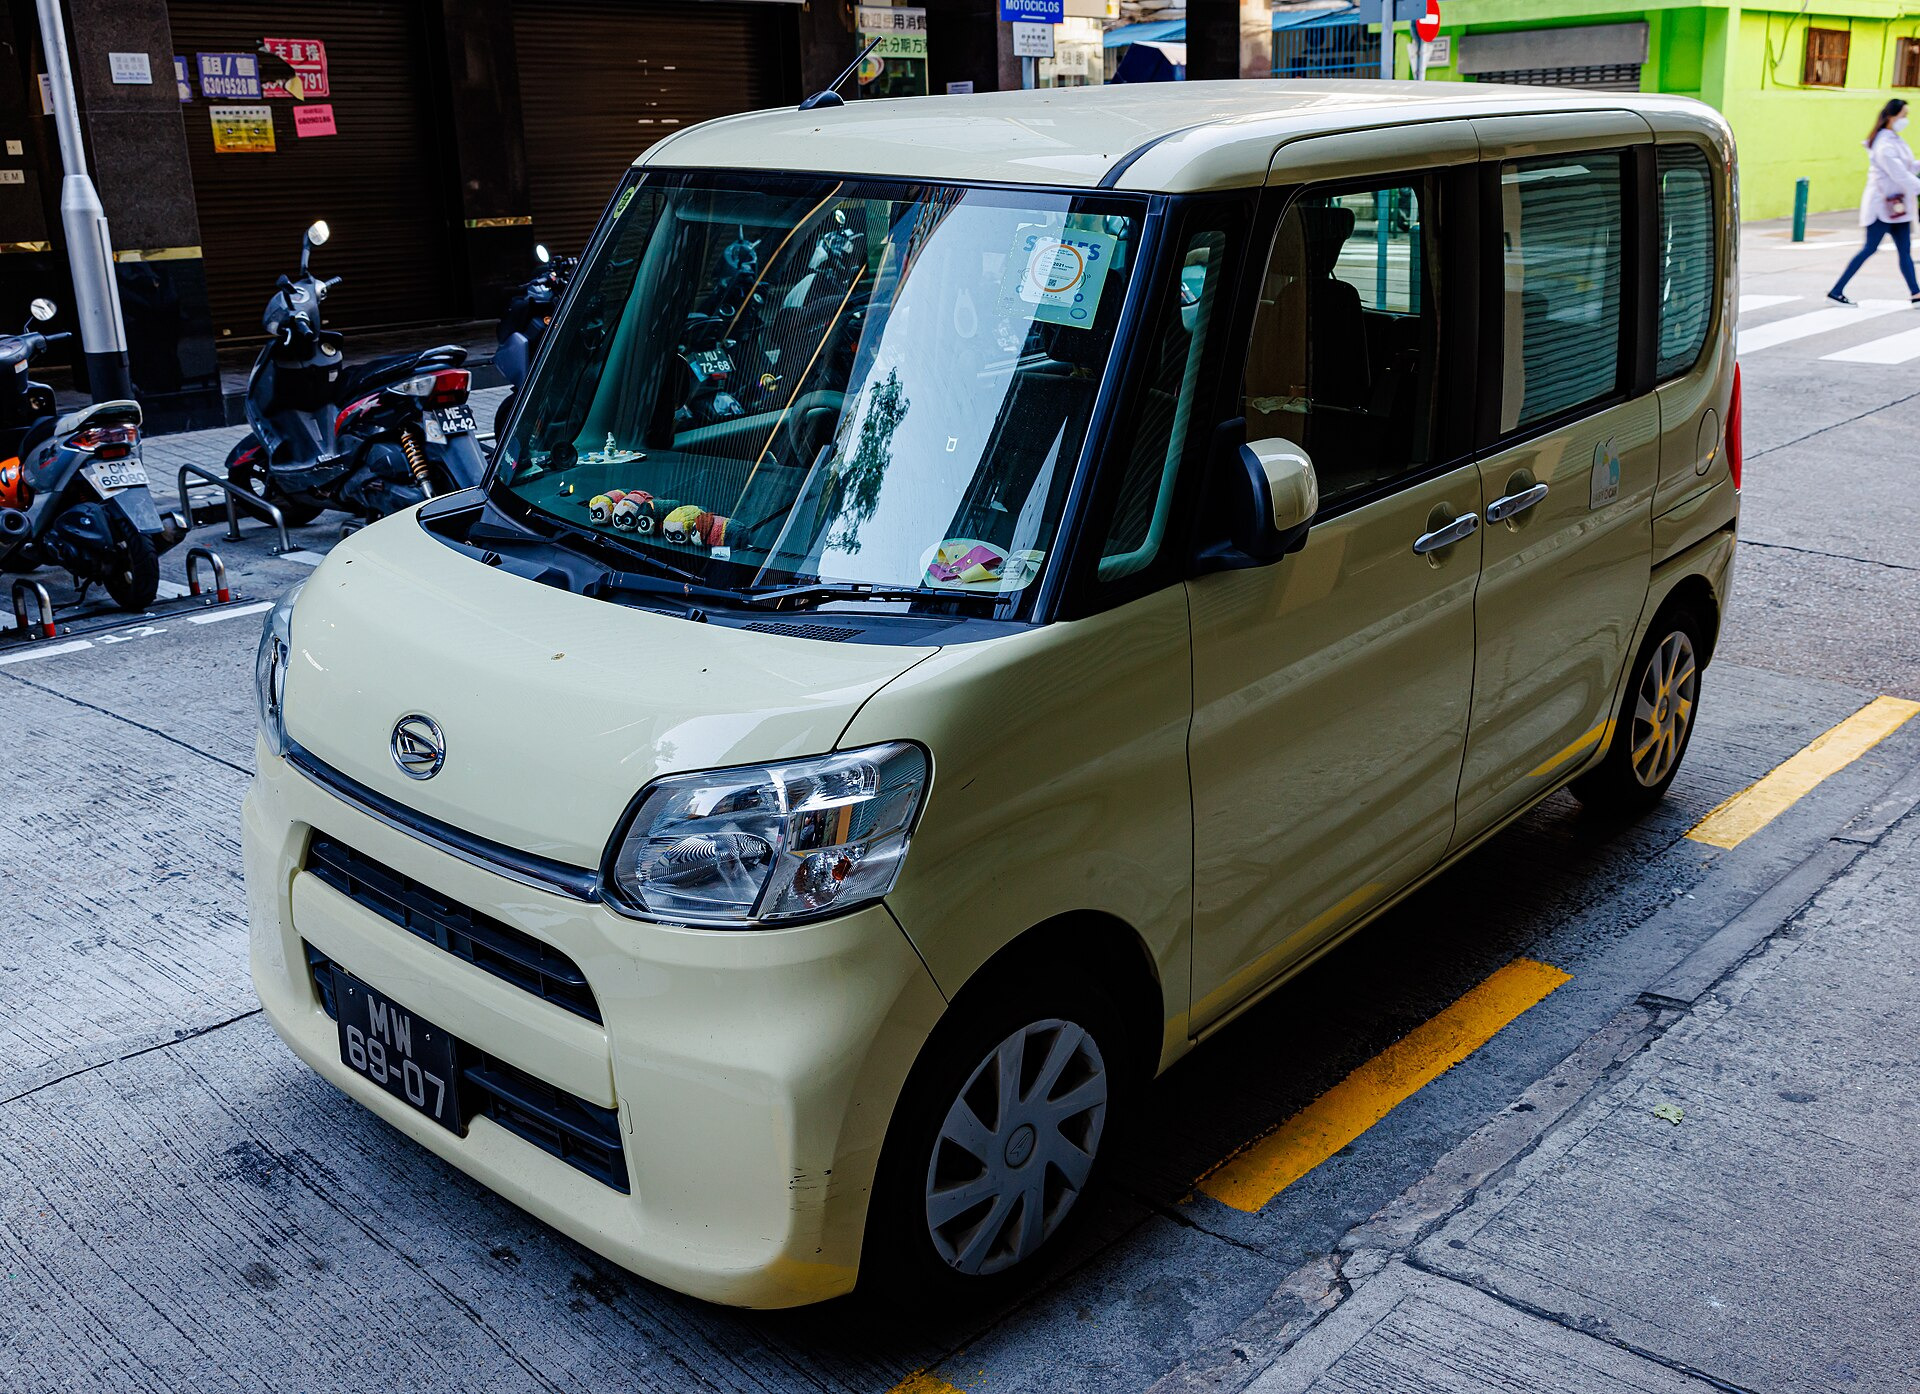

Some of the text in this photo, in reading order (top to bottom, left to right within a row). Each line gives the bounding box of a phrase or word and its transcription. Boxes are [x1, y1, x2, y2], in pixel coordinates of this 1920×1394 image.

[1005, 0, 1060, 13] MOTOCICLOS
[264, 43, 321, 61] 主直接
[704, 350, 718, 362] MU
[700, 361, 730, 374] 72-68
[444, 406, 463, 420] ME
[442, 418, 475, 432] 44-42
[367, 994, 412, 1058] MW
[346, 1024, 445, 1119] 69-07
